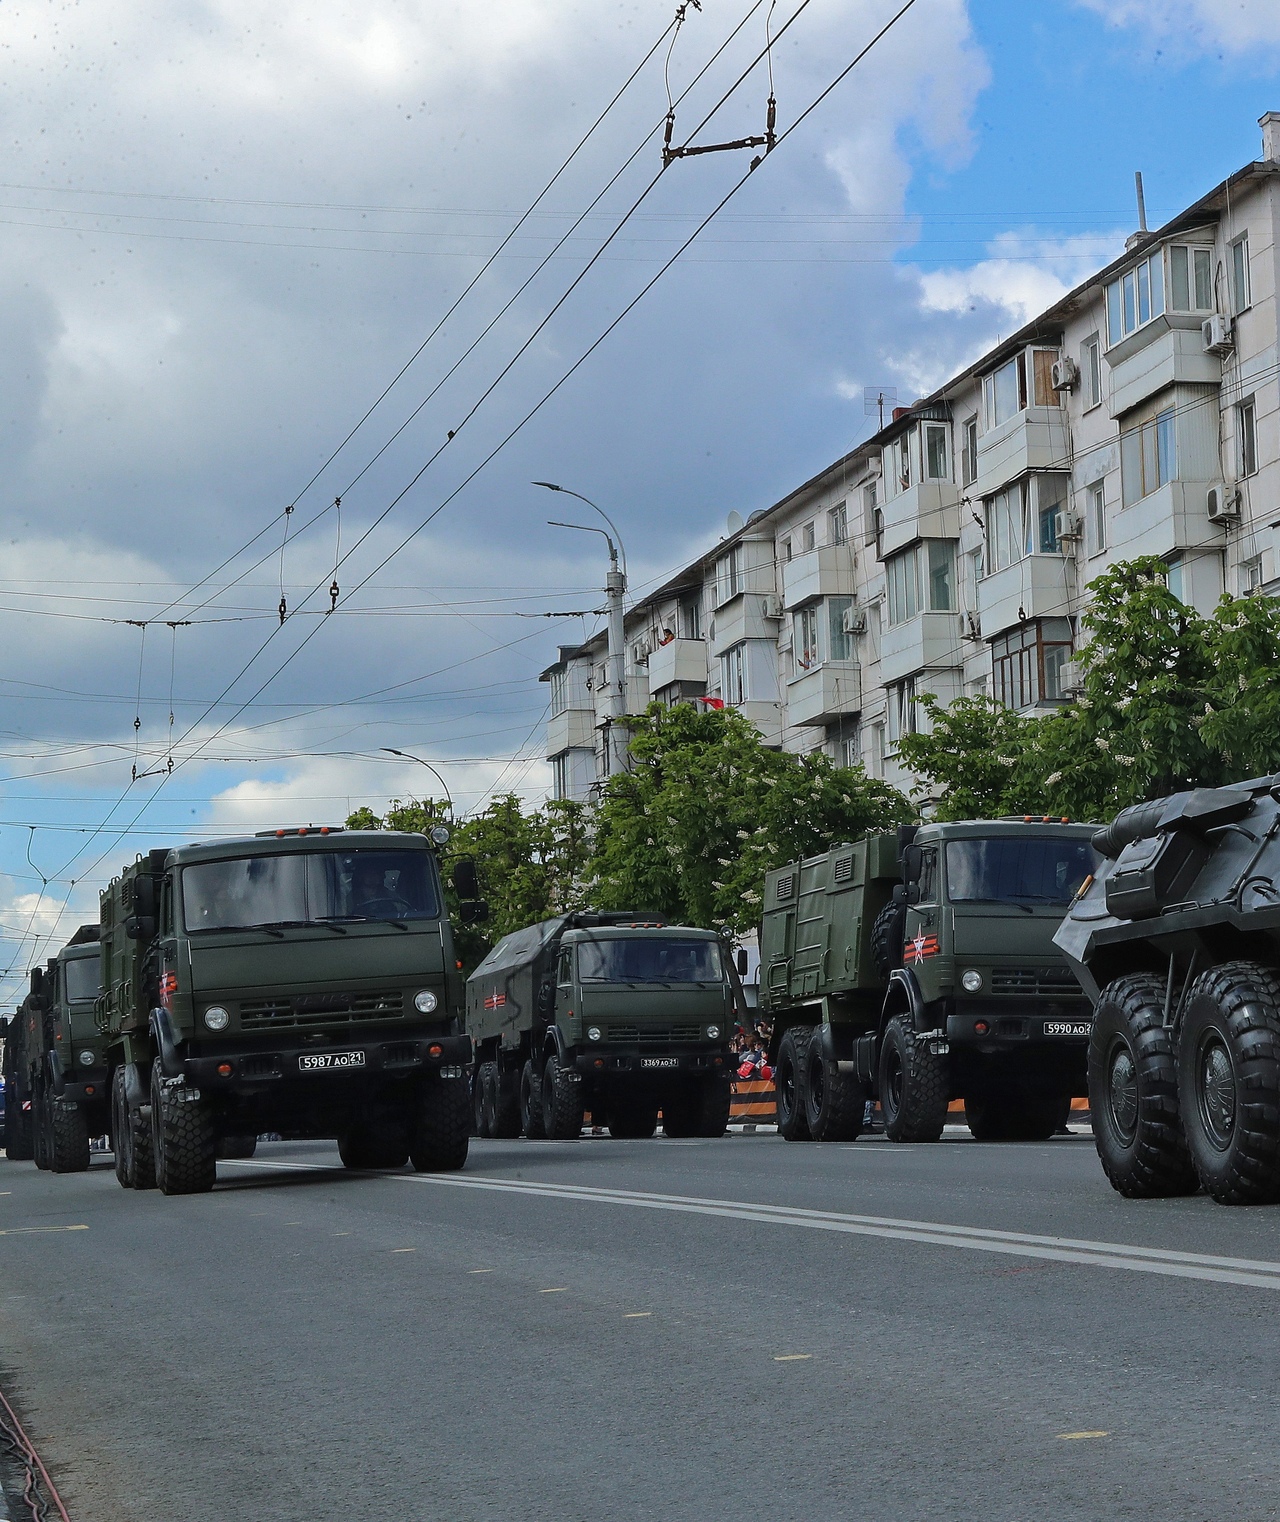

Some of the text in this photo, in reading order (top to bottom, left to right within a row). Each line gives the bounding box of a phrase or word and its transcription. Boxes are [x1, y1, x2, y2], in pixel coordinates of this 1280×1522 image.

[1048, 1023, 1072, 1034] 5990
[304, 1055, 332, 1069] 5987
[350, 1053, 361, 1063] 21
[643, 1059, 660, 1067] 3369
